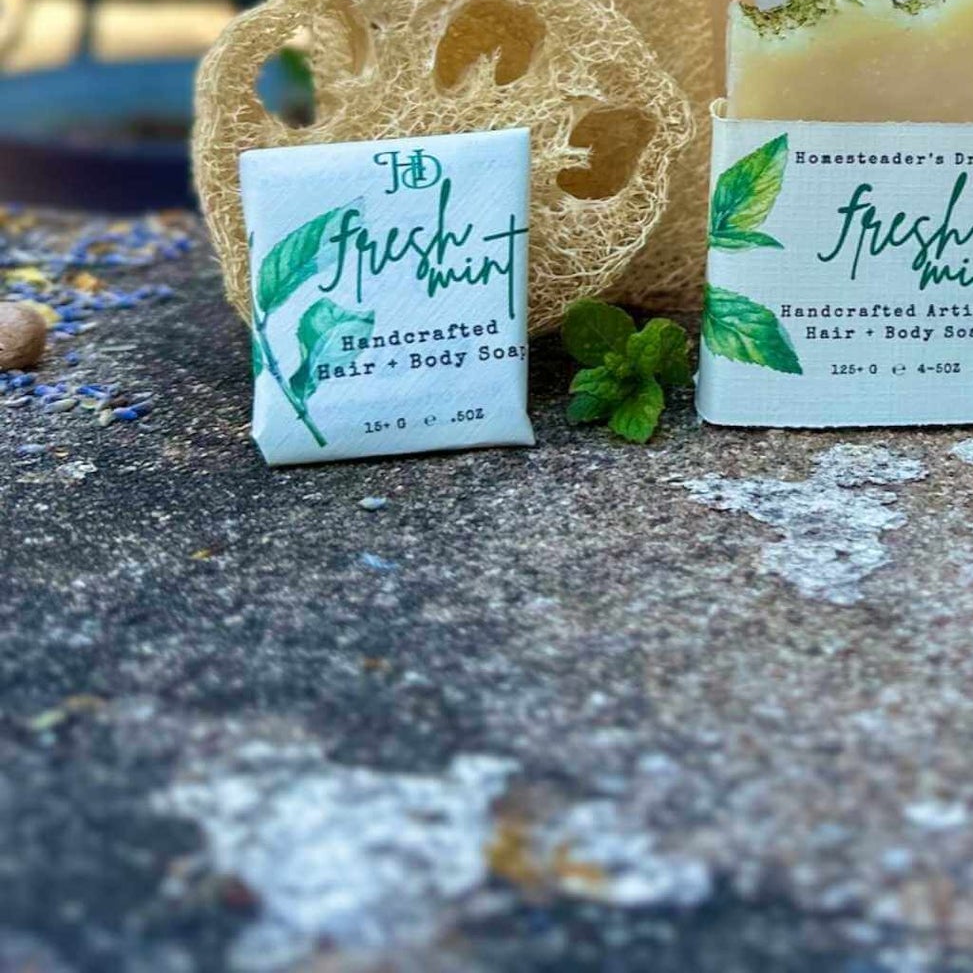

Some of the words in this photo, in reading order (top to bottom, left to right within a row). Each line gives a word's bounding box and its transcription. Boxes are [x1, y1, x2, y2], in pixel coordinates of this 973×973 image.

[795, 151, 945, 165] Homesteader's
[318, 178, 473, 304] fresh
[427, 214, 529, 320] mint
[780, 304, 917, 318] Handcrafted
[341, 319, 499, 352] Handcrafted
[806, 326, 855, 340] Hair
[885, 326, 935, 342] Body
[317, 361, 375, 381] Hair
[410, 350, 467, 369] Body
